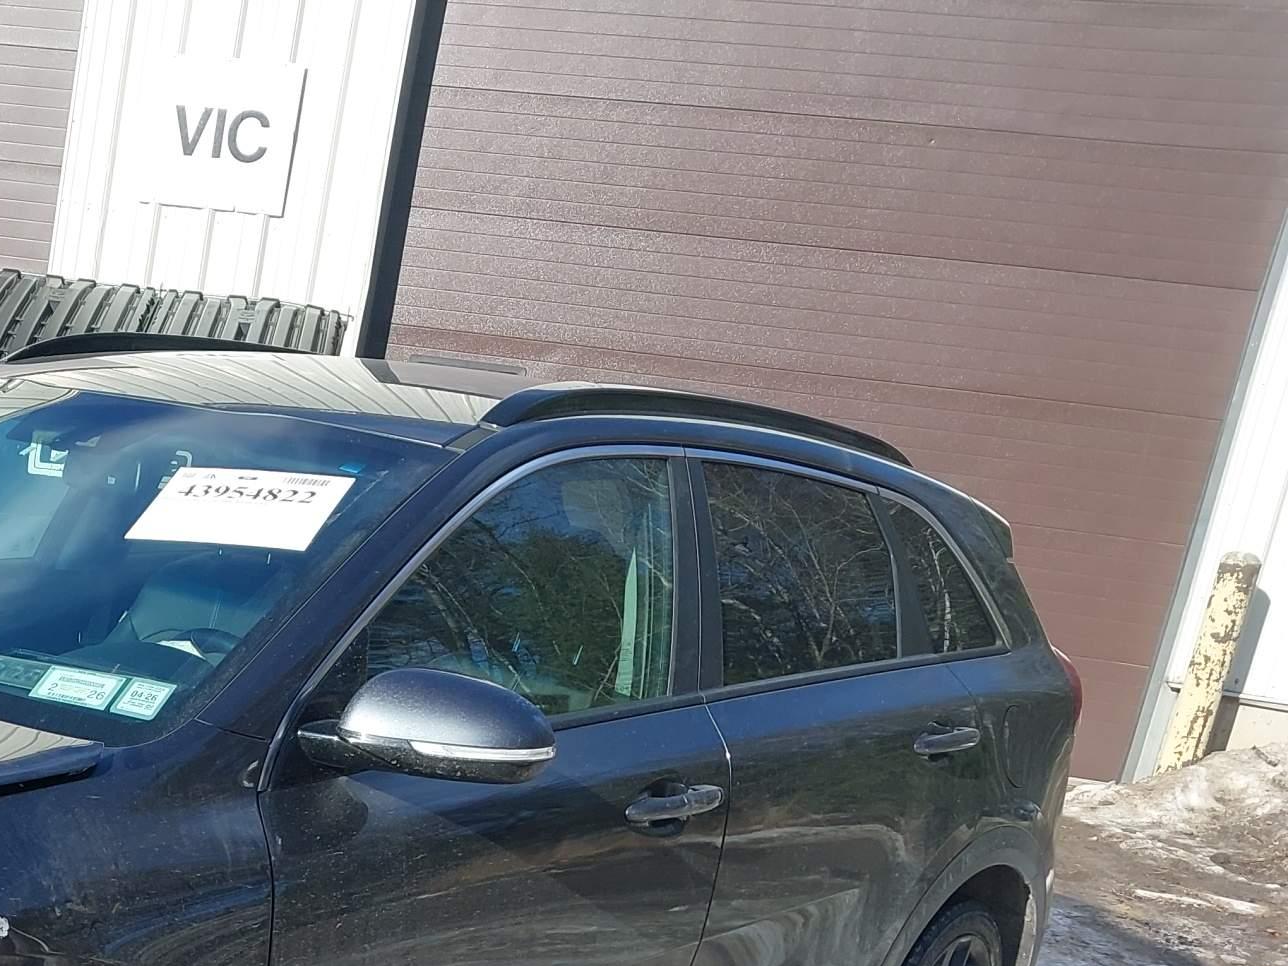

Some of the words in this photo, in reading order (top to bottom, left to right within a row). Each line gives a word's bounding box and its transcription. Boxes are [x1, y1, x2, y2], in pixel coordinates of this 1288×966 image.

[175, 104, 271, 164] VIC
[178, 483, 317, 504] 43954822
[86, 690, 106, 701] 26
